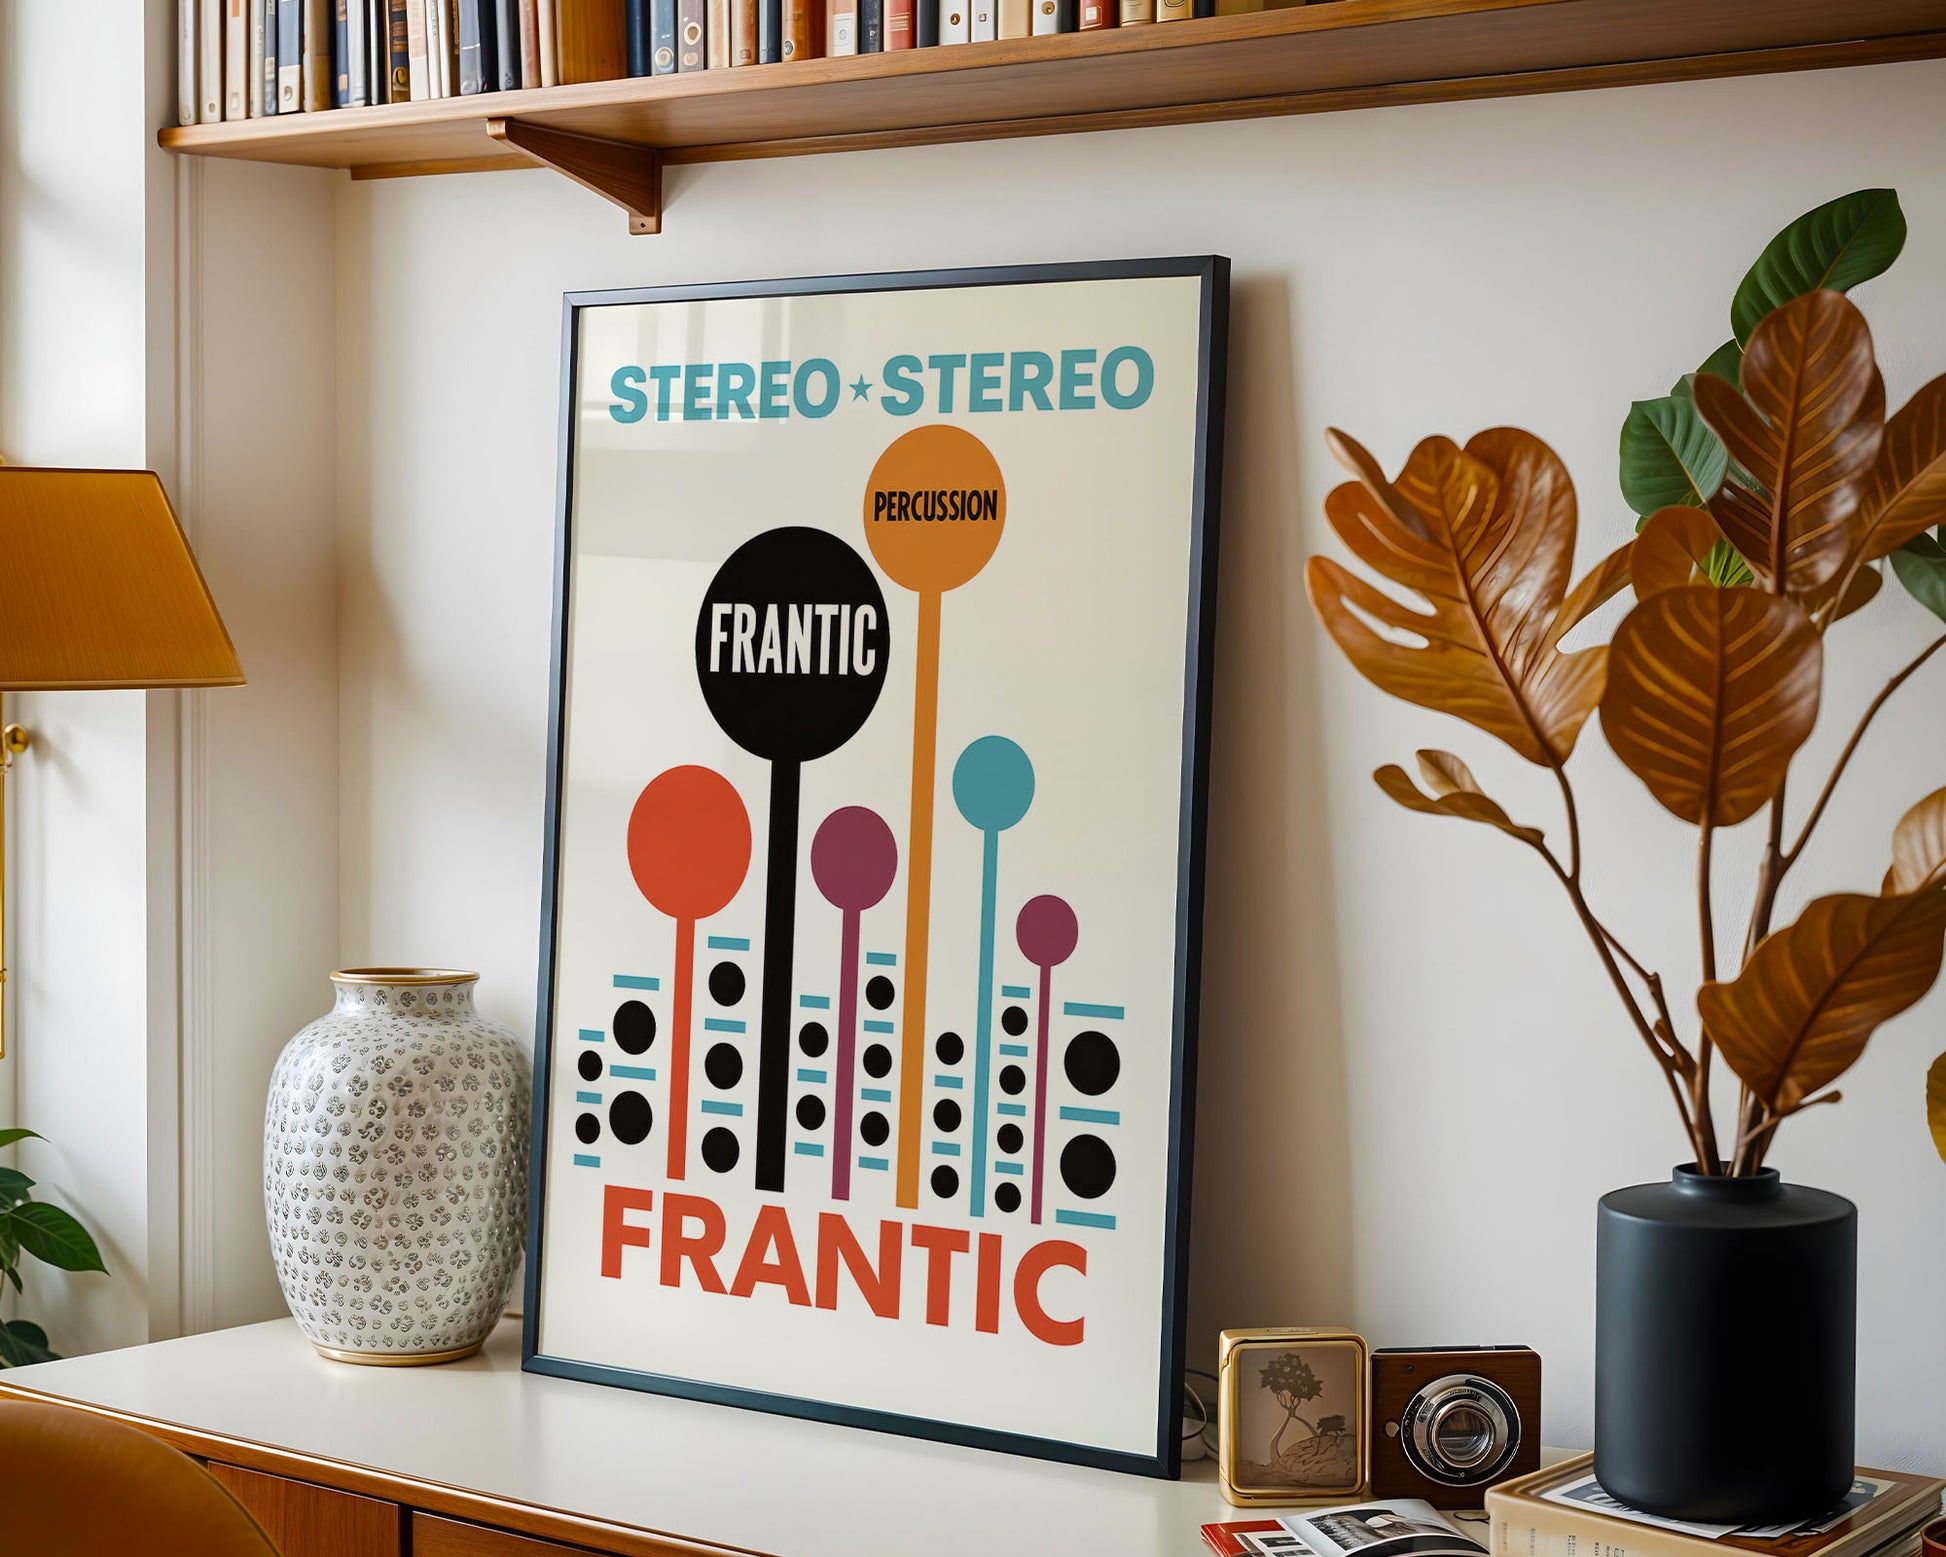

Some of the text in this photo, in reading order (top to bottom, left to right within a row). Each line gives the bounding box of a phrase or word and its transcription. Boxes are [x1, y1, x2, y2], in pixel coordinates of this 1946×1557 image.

[609, 346, 1154, 423] STEREO STEREO
[873, 490, 998, 522] PERCUSSION
[709, 603, 877, 676] FRANTIC
[601, 1185, 1087, 1346] FRANTIC
